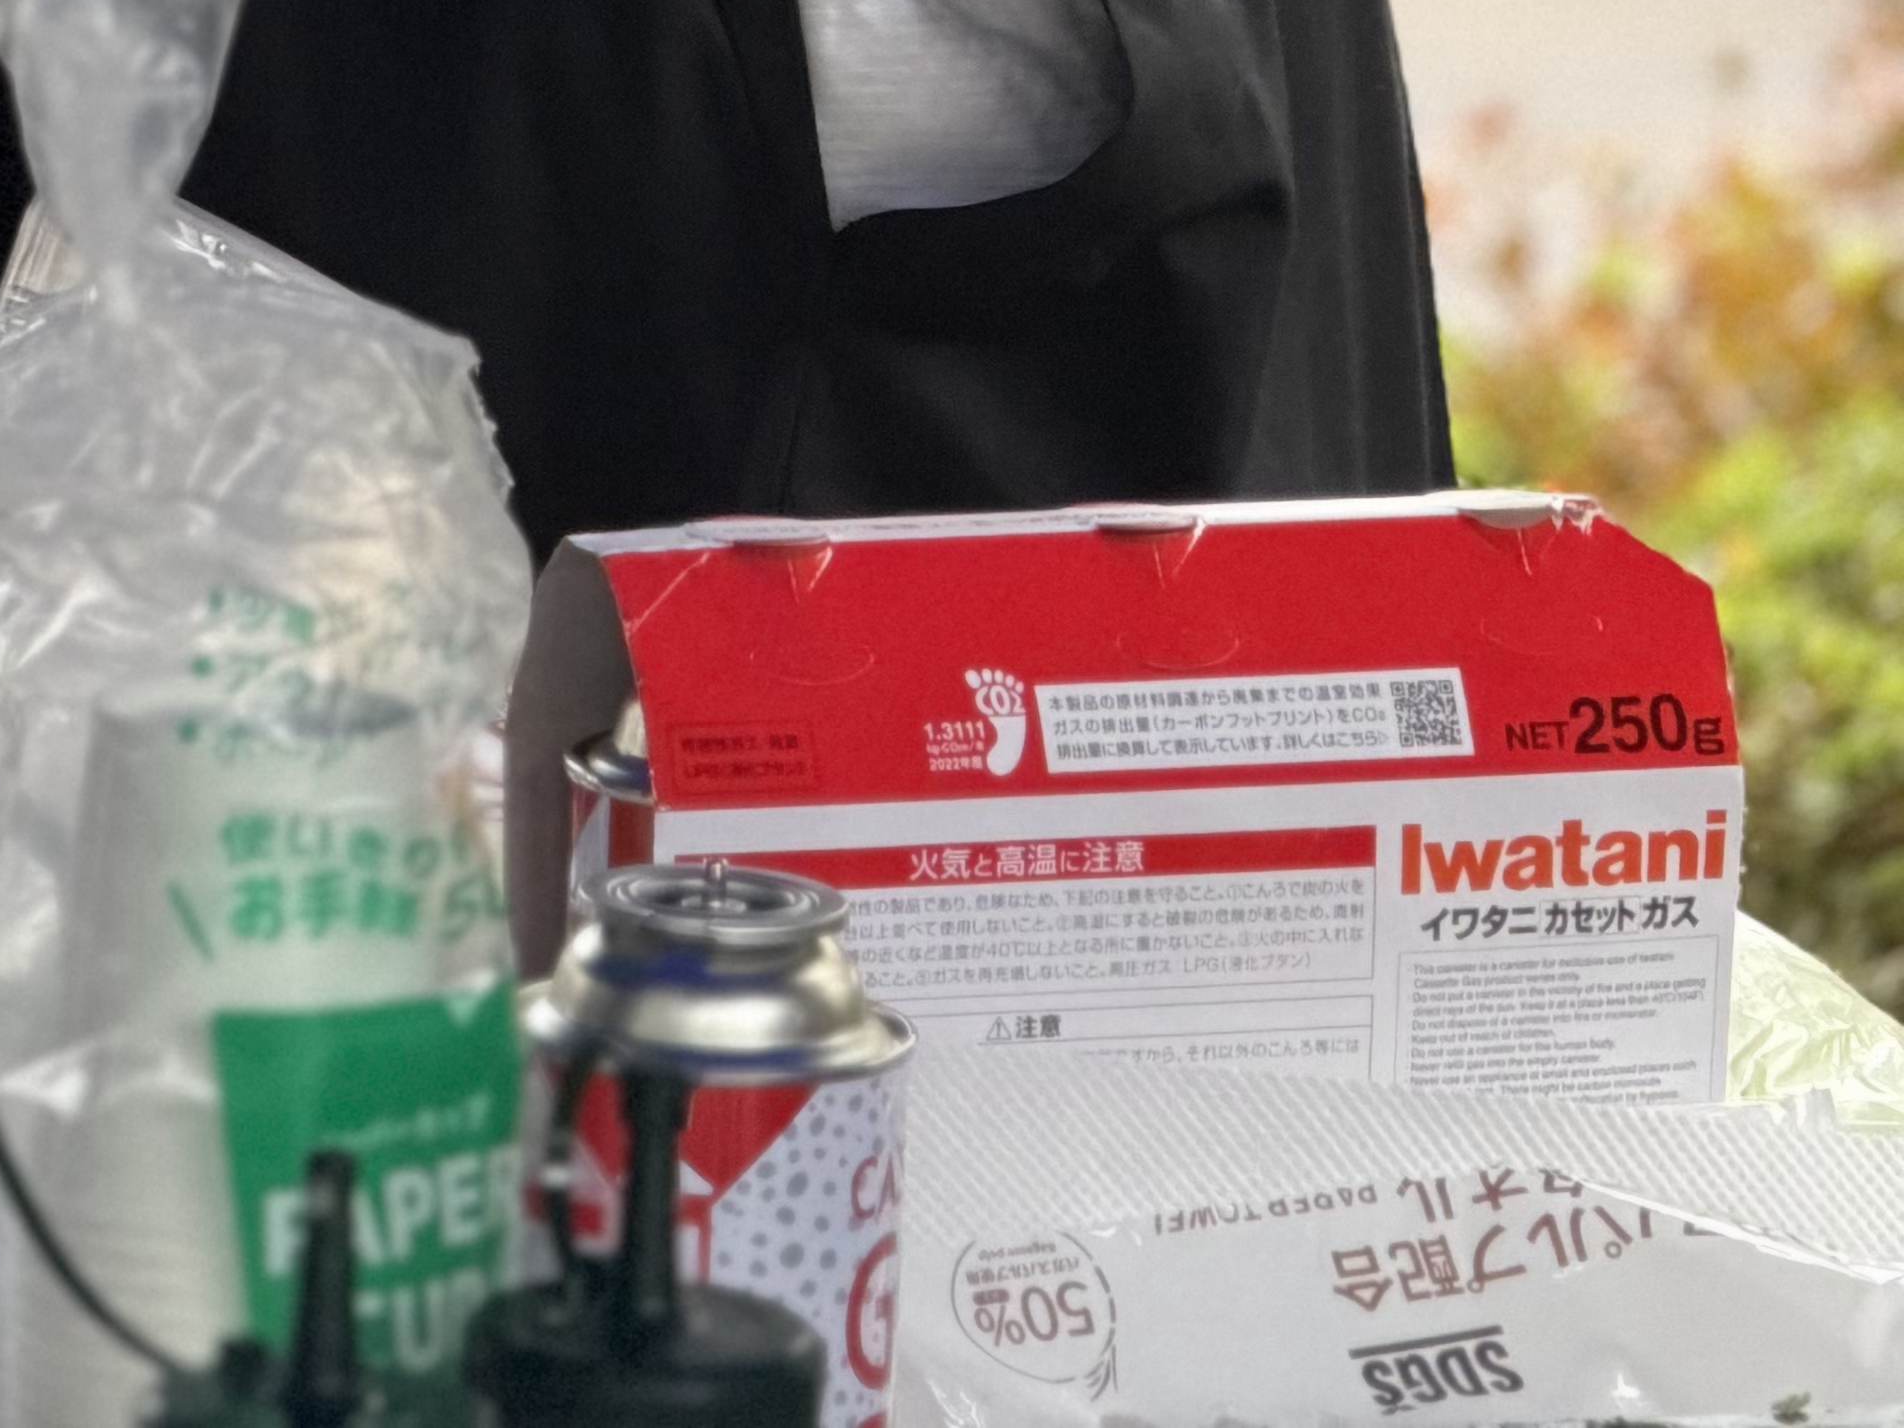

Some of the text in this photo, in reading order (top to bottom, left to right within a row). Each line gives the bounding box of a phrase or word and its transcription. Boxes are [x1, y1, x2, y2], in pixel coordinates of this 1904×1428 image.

[924, 721, 985, 741] 1.3111
[1506, 693, 1725, 756] NET 250g
[910, 841, 1146, 882] 火気と高温に注意
[1400, 809, 1728, 896] Iwatani
[1015, 1014, 1062, 1039] 注意
[973, 1280, 1096, 1347] 50%
